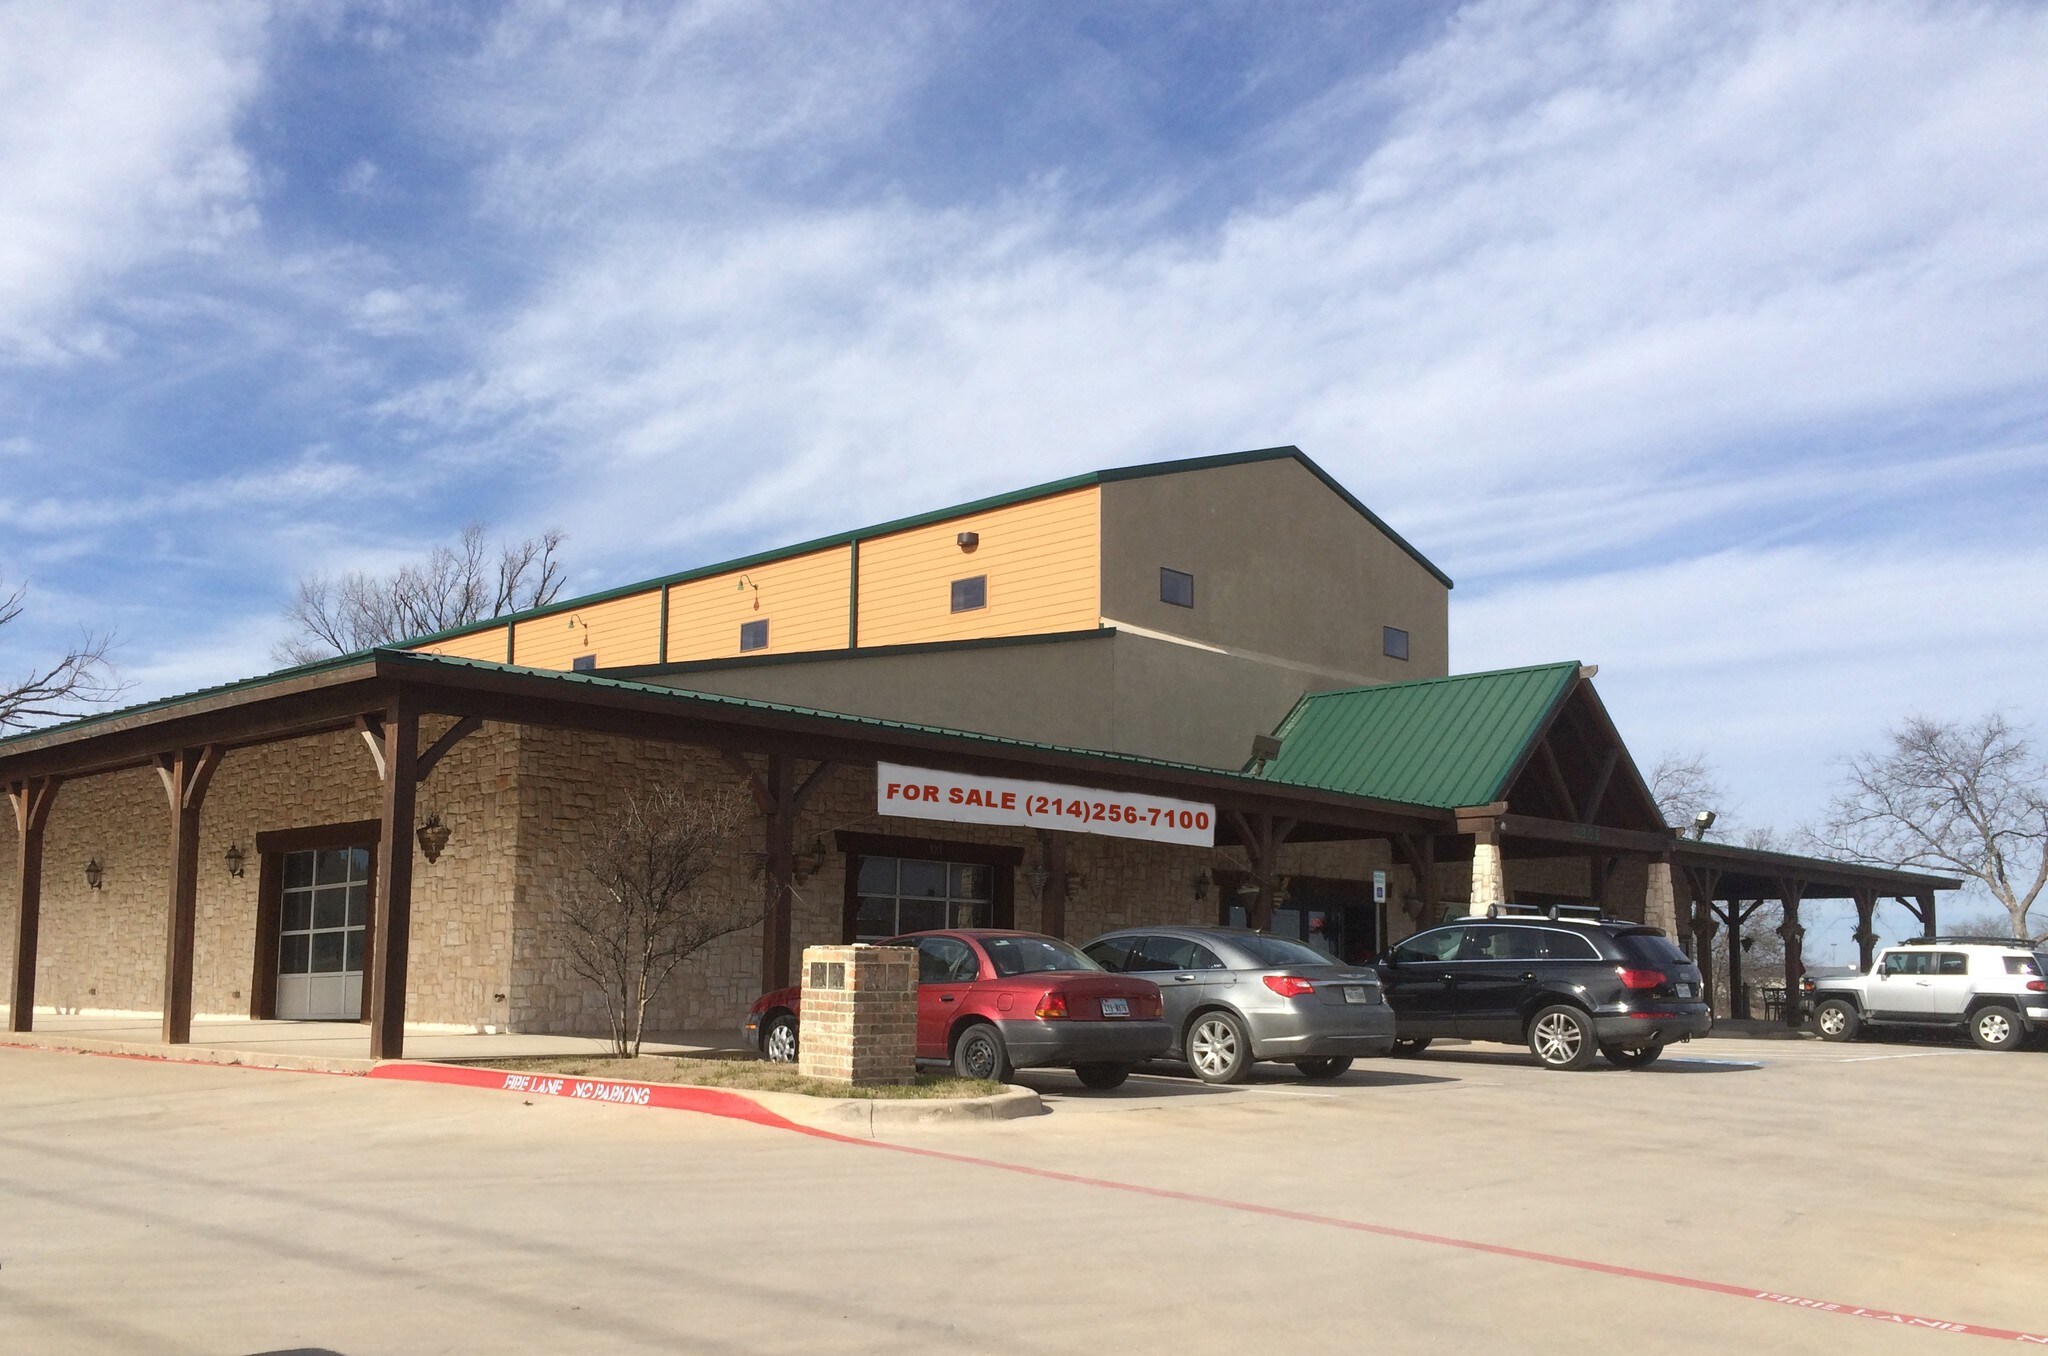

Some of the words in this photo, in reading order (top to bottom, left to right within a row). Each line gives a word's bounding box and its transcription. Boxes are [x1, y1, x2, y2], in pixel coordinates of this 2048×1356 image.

[886, 783, 939, 802] FOR
[948, 787, 1016, 810] SALE
[1025, 795, 1209, 831] (214)256-7100
[503, 1074, 530, 1091] FIRE
[531, 1078, 564, 1095] LANE
[571, 1081, 593, 1098] NO
[592, 1084, 650, 1105] PARKING
[1755, 1292, 1840, 1312] FIRE
[1851, 1308, 1967, 1333] LANE
